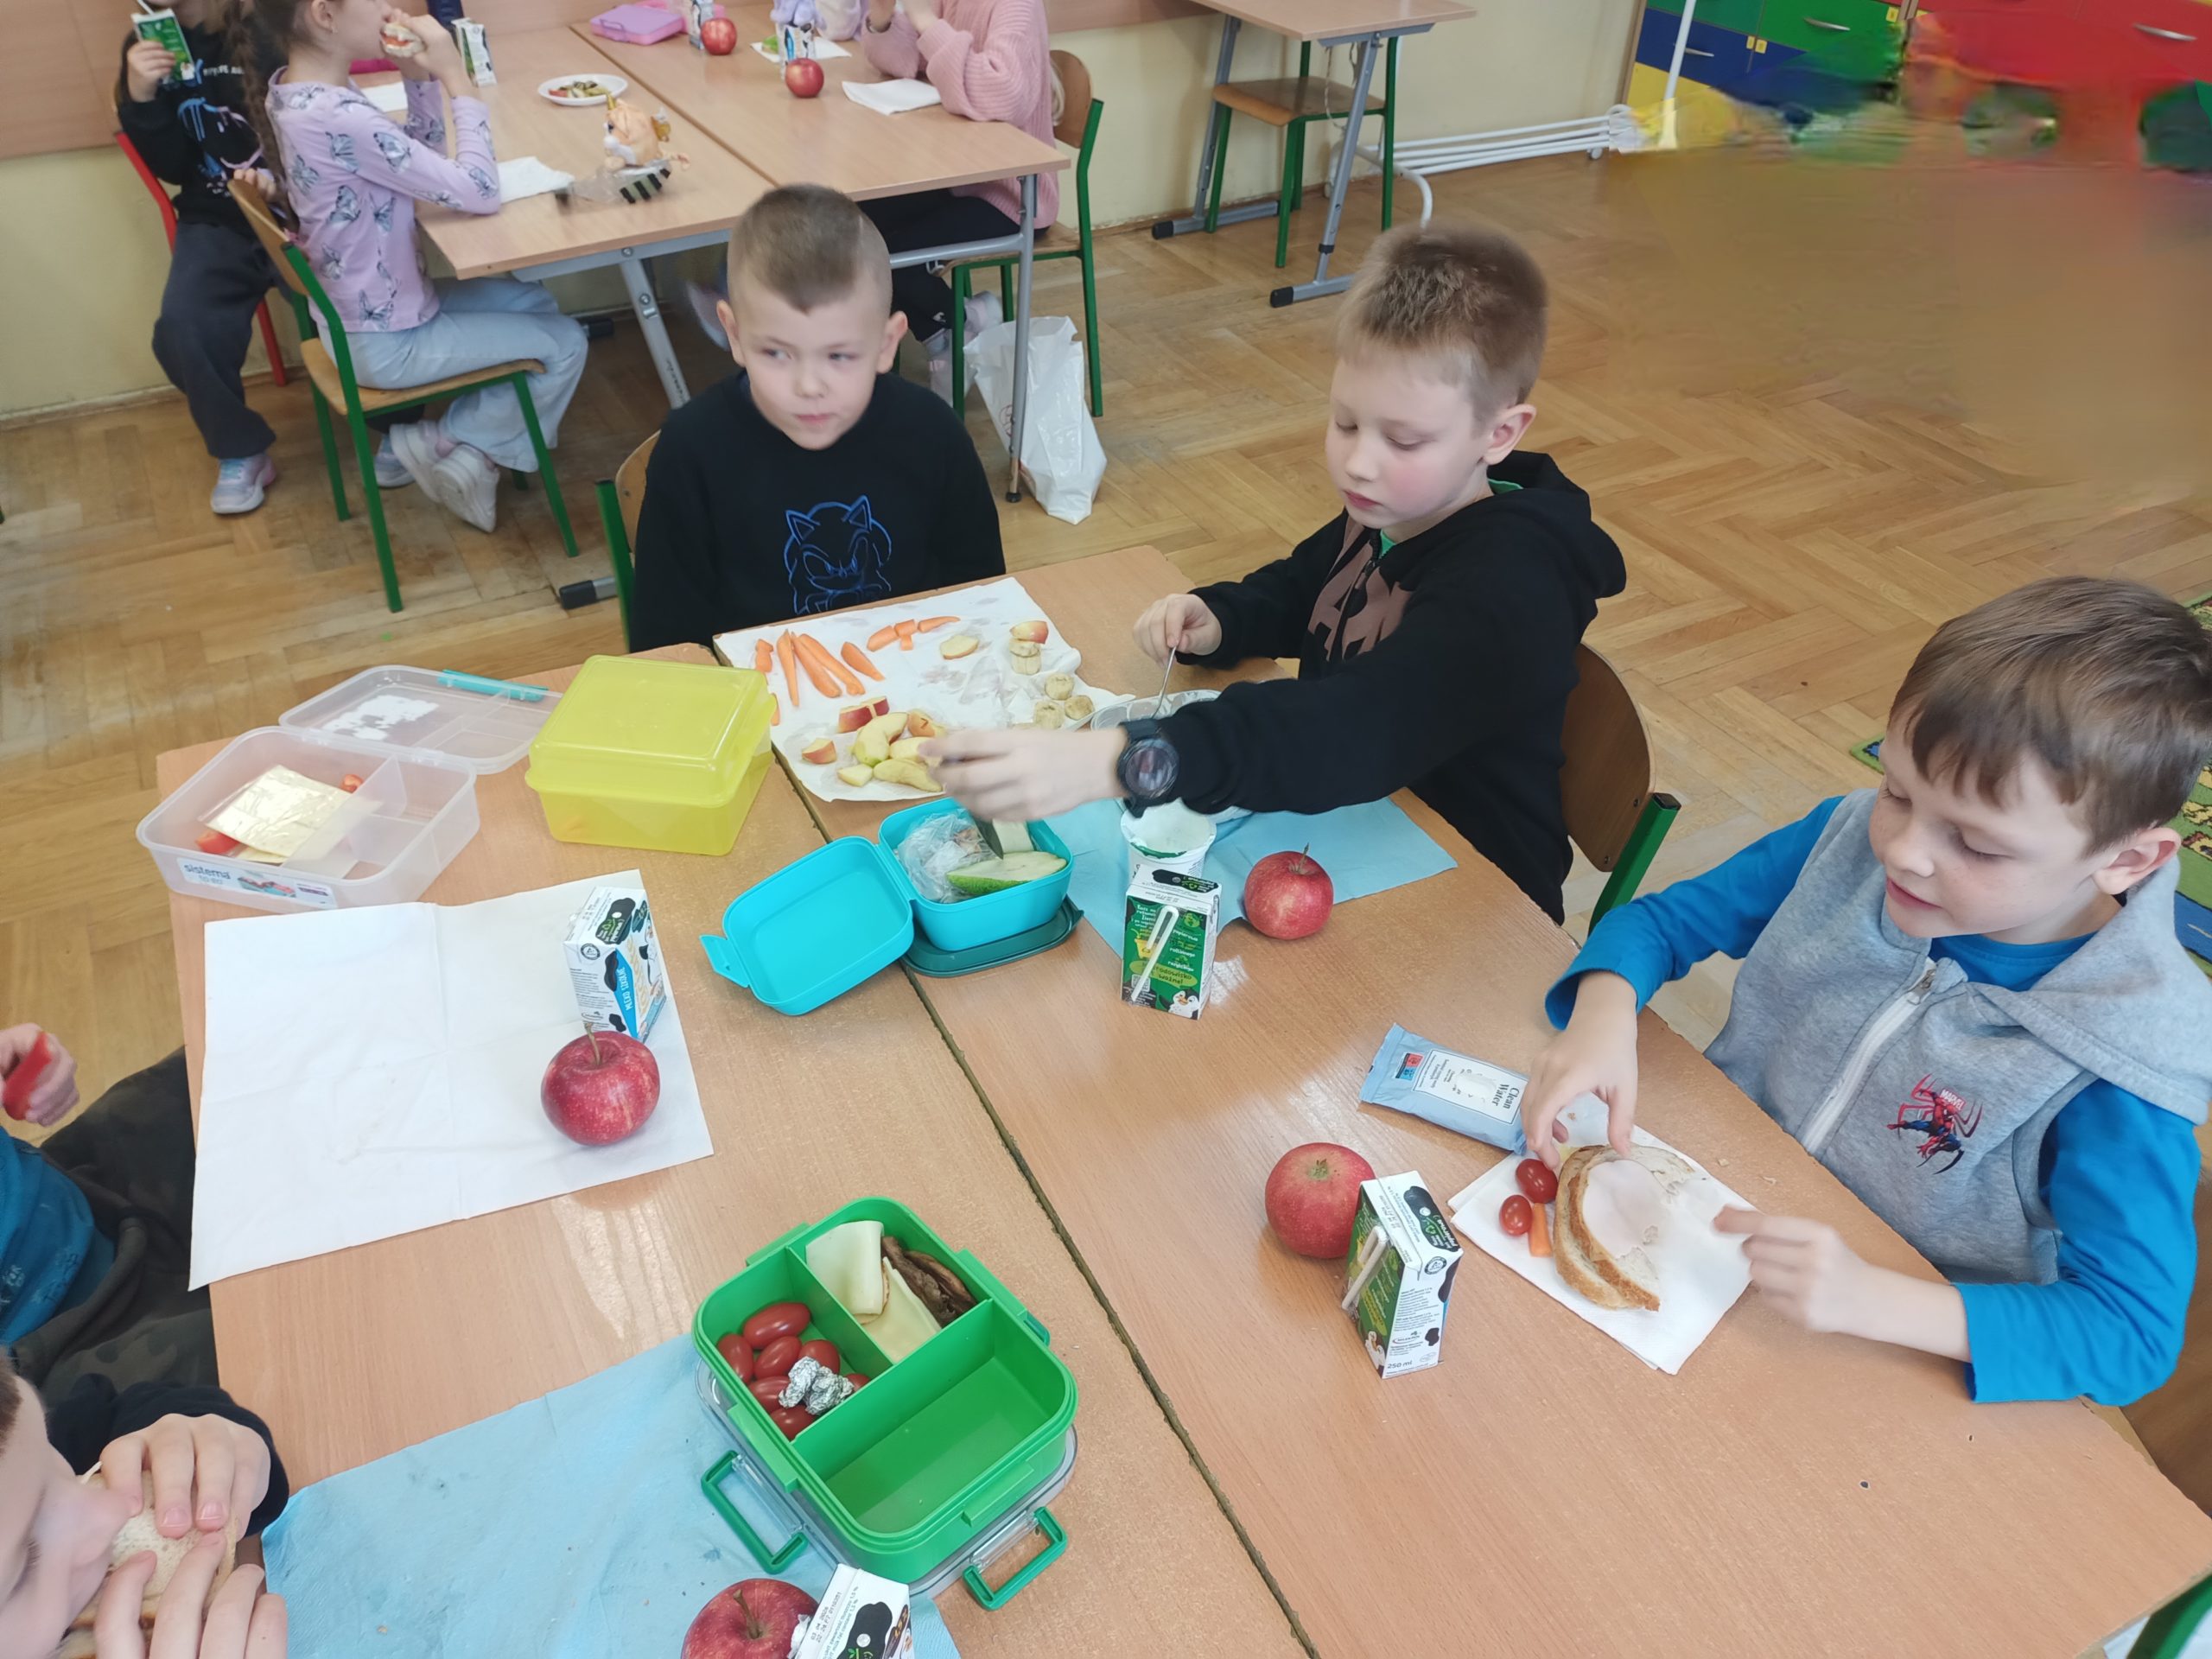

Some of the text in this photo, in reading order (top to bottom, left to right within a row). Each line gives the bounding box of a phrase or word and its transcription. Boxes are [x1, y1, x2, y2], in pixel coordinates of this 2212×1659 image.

[184, 864, 231, 880] sistema
[1155, 967, 1192, 980] rodowisko
[1491, 1084, 1510, 1107] Water
[1503, 1087, 1519, 1109] Clean
[1939, 1089, 1965, 1111] MARVEL
